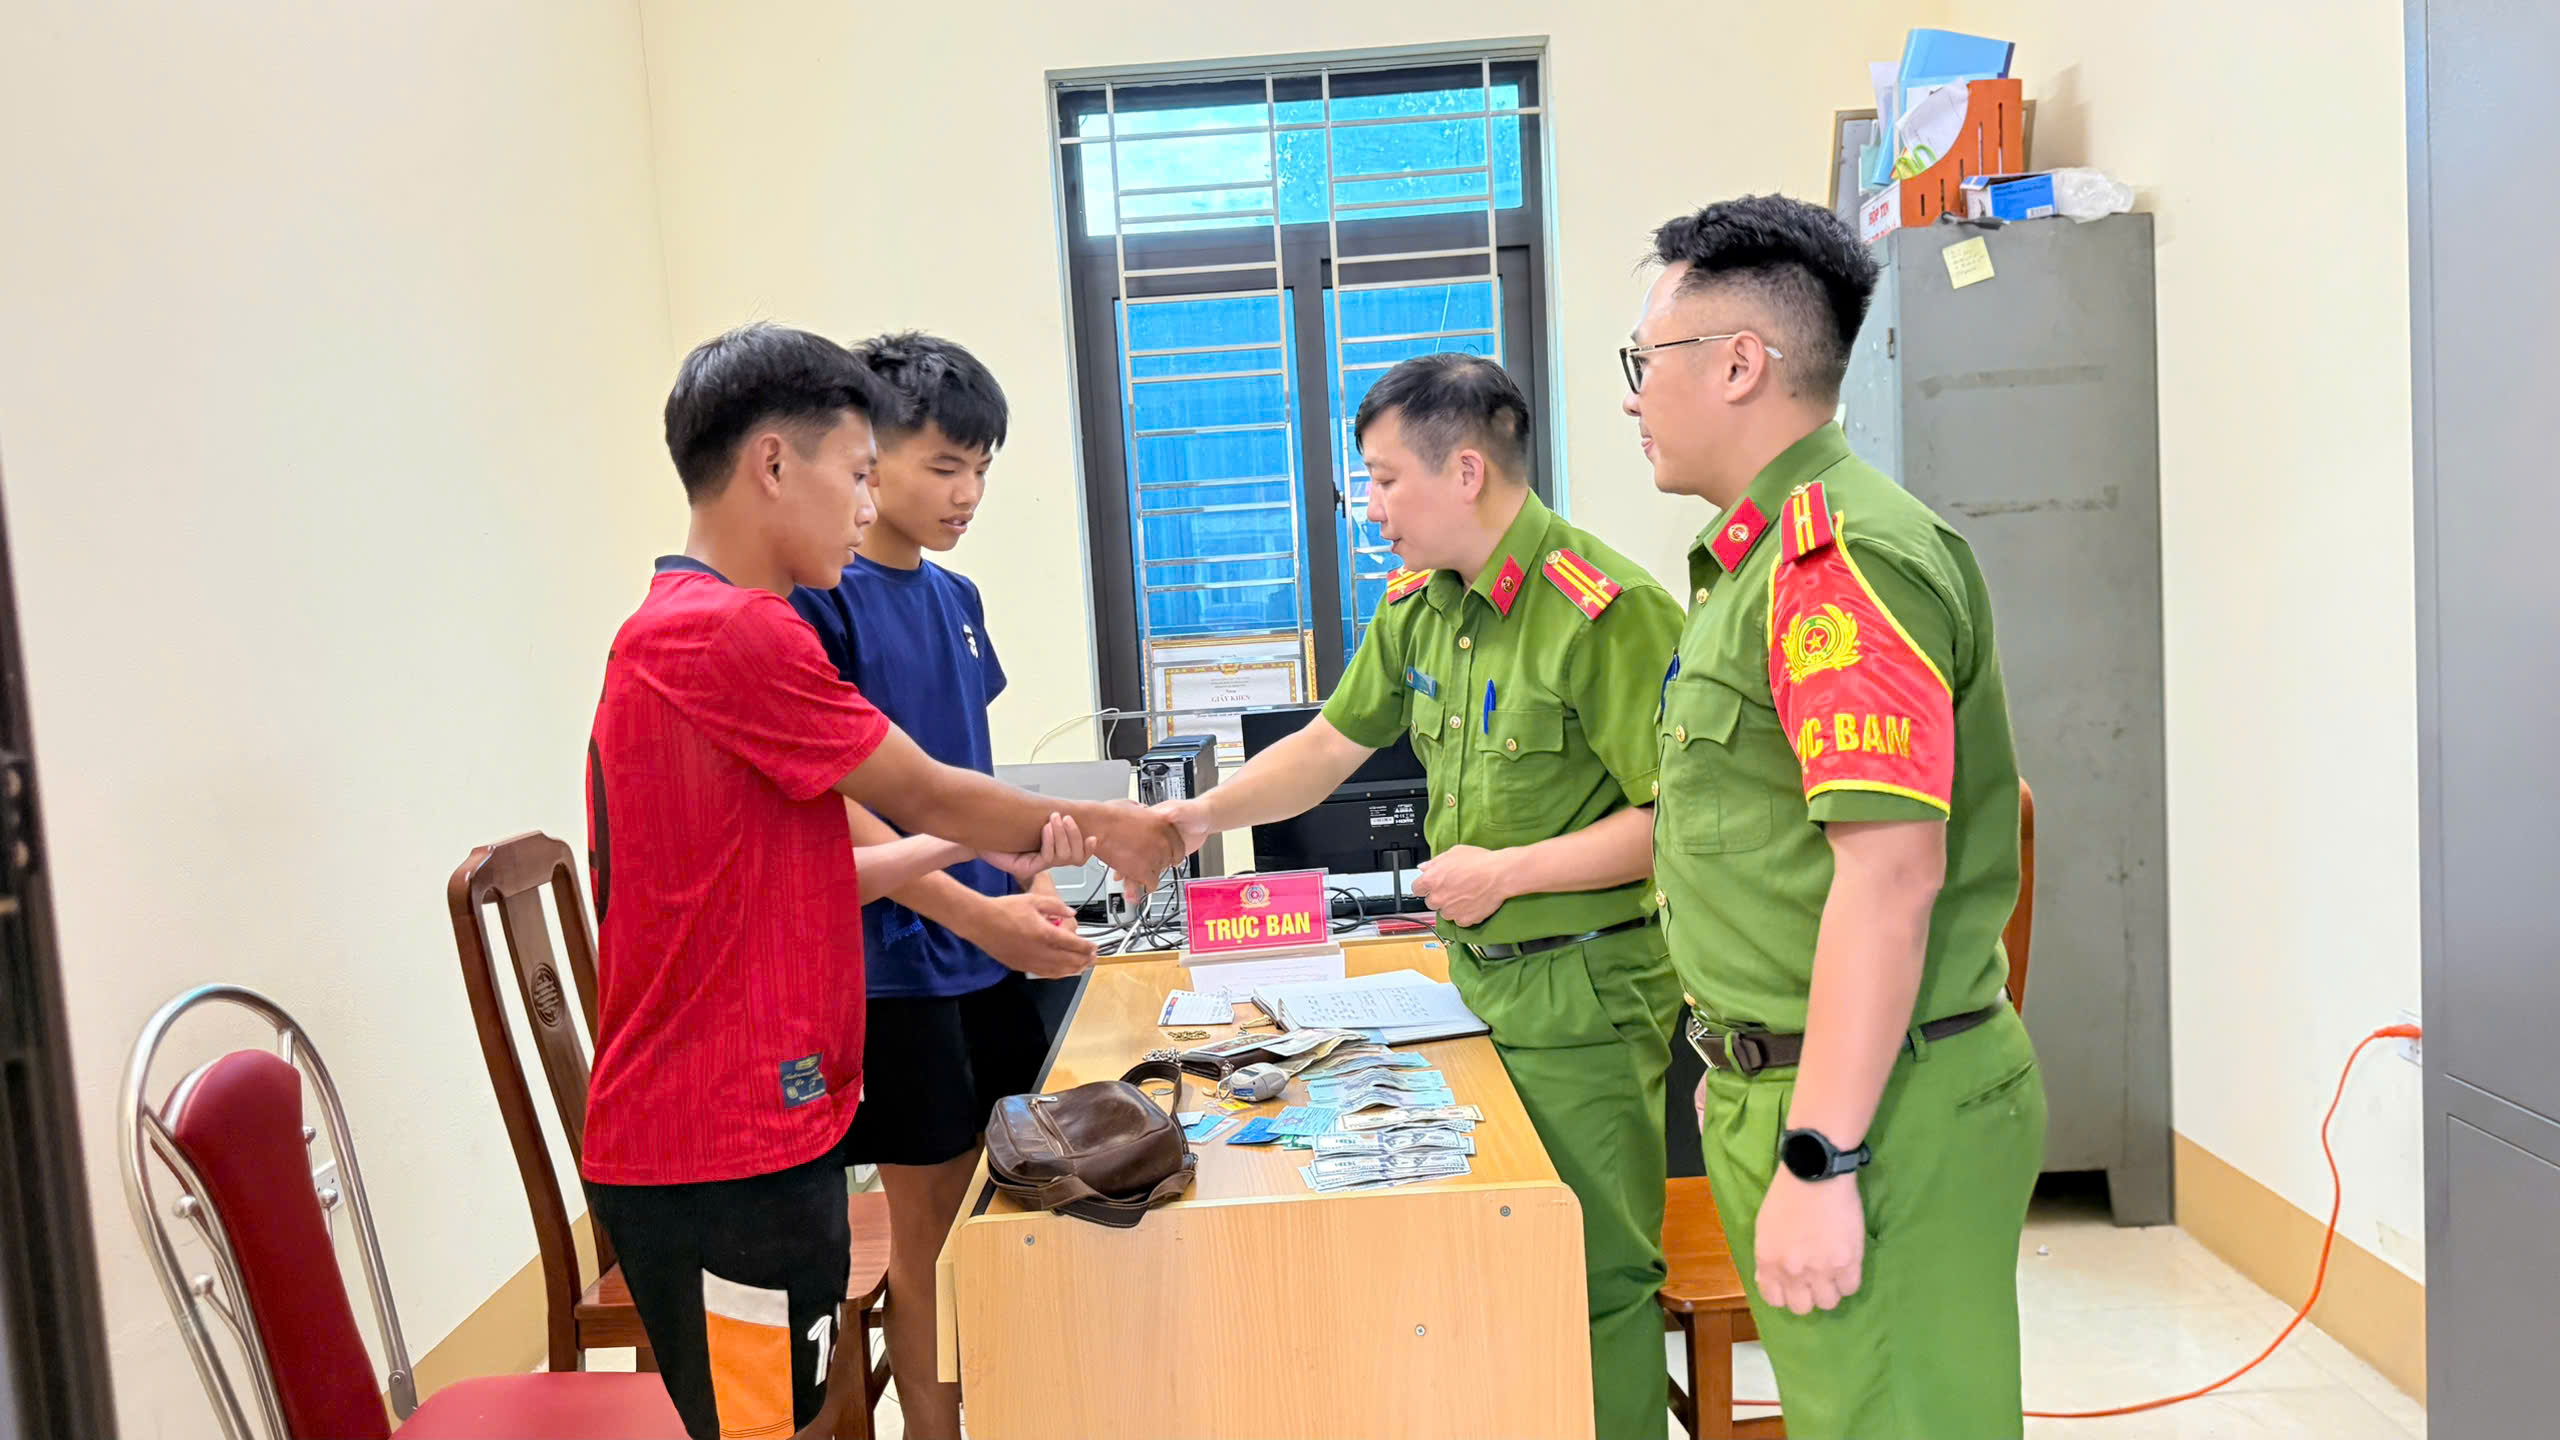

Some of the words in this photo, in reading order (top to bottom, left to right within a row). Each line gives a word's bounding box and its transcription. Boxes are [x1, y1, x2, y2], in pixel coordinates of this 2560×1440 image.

[1834, 713, 1911, 758] BAN
[1205, 914, 1259, 944] TRỰC
[1265, 912, 1311, 937] BAN
[807, 1303, 840, 1387] 1
